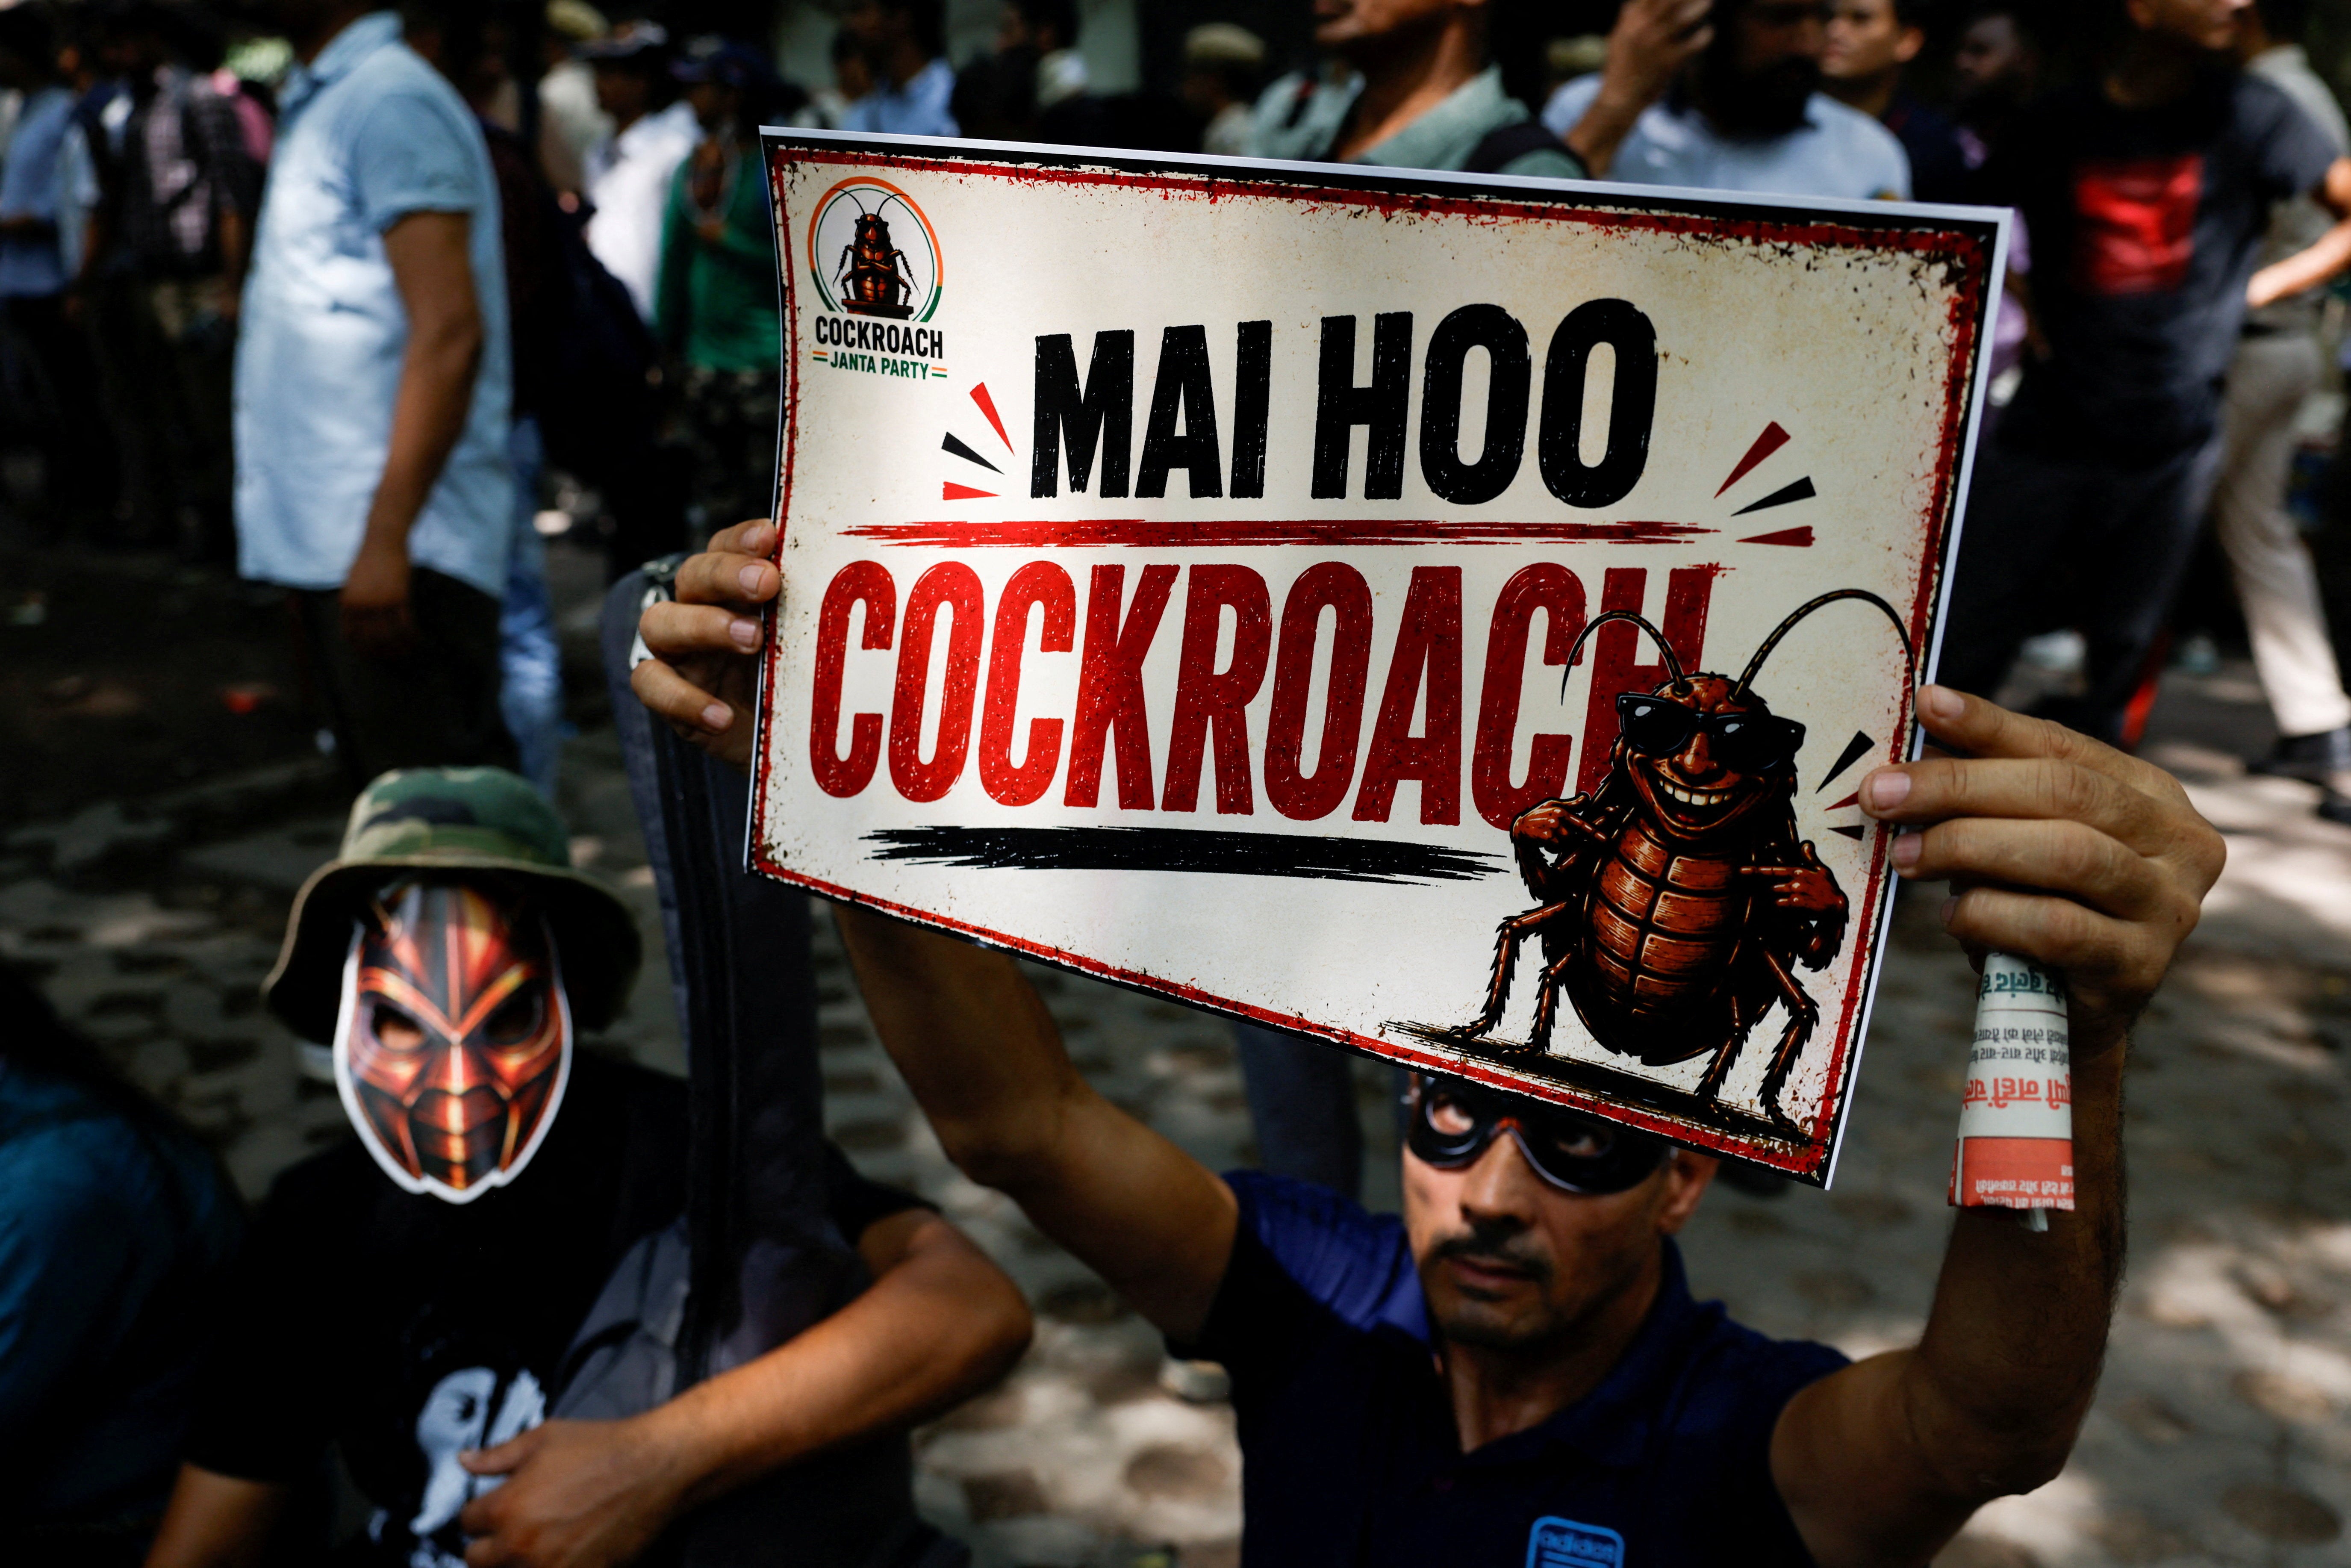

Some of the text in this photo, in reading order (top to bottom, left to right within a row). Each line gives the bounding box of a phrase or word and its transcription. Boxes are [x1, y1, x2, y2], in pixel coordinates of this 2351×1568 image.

[815, 315, 943, 359] COCKROACH
[831, 351, 929, 380] JANTA PARTY
[1030, 297, 1659, 510] MAI HOO
[809, 560, 1718, 833] COCKROACH
[1994, 967, 2043, 998] बुलंद
[2024, 1048, 2046, 1064] और
[1988, 1078, 2042, 1108] नहीं
